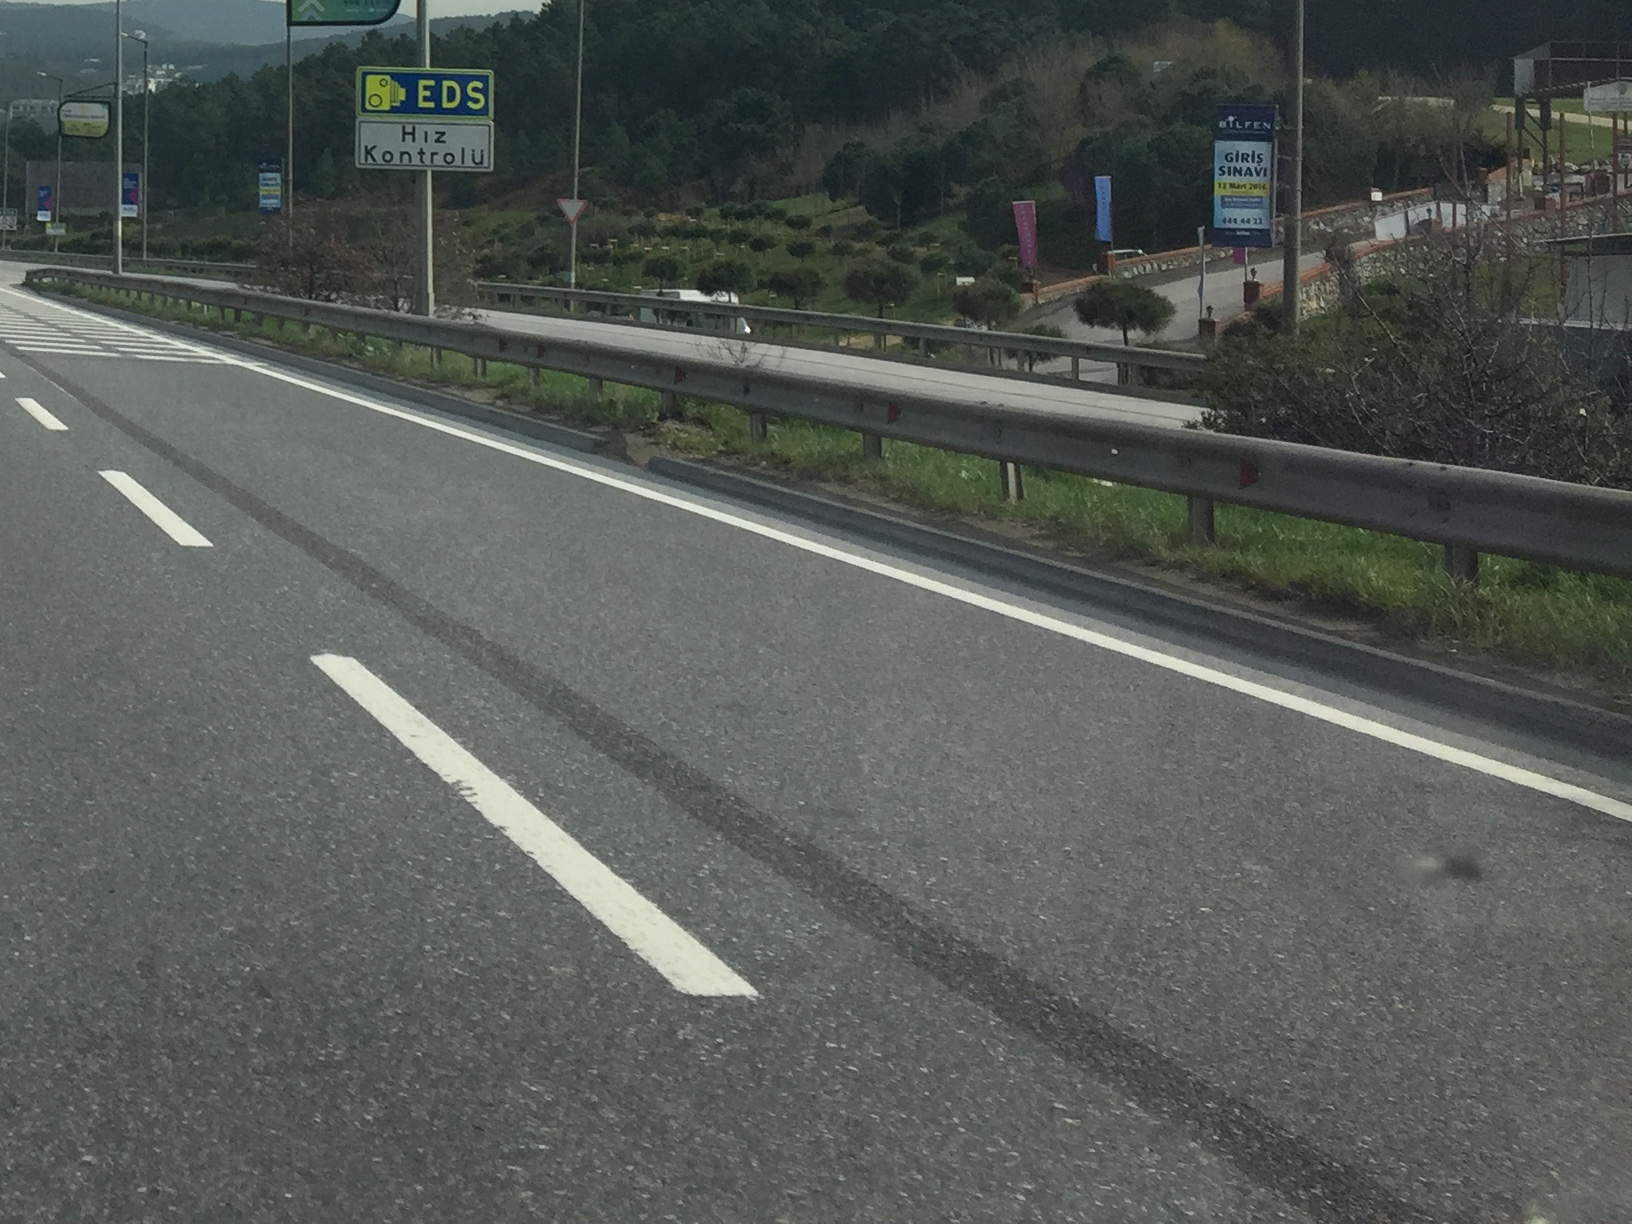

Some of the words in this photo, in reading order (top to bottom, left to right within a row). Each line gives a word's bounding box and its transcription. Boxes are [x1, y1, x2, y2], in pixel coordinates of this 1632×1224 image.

[417, 79, 486, 110] EDS
[401, 125, 447, 144] Hız
[364, 145, 485, 166] Kontrolü
[1224, 148, 1264, 166] GİRİŞ
[1218, 165, 1268, 178] SINAVI
